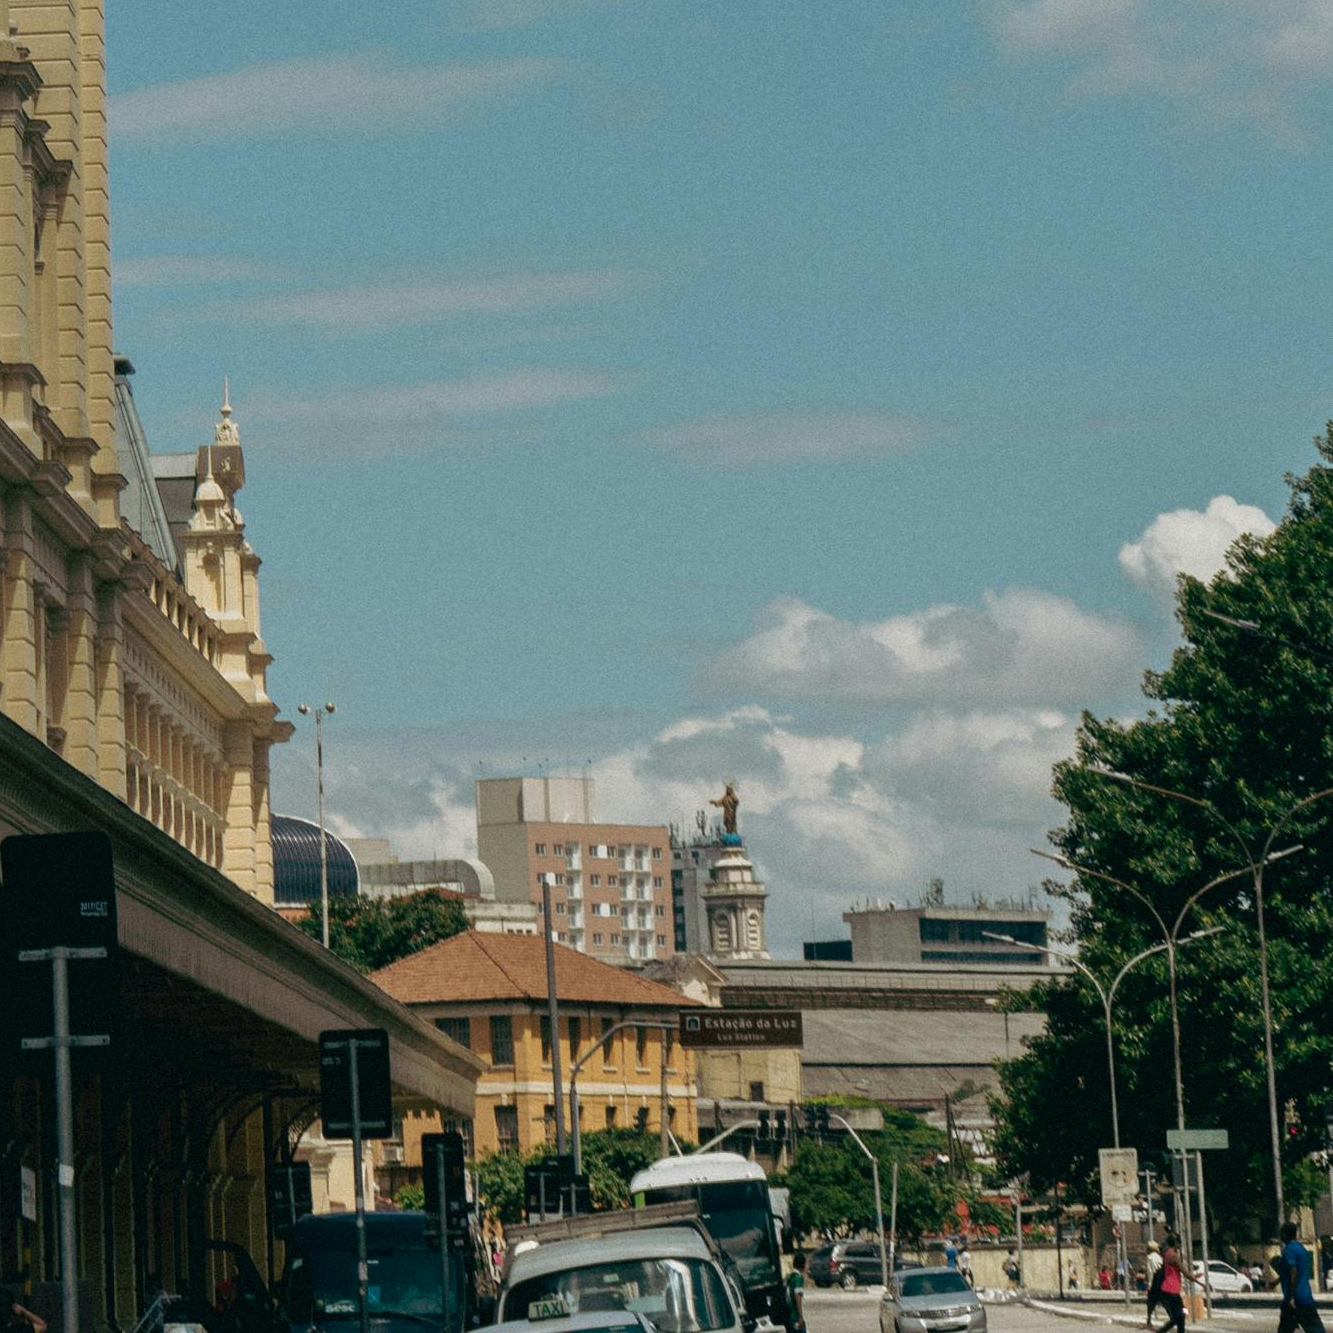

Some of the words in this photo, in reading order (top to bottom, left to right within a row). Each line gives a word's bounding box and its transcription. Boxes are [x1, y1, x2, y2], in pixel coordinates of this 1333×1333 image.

[704, 1017, 753, 1030] Estação
[756, 1017, 771, 1029] da
[774, 1017, 797, 1029] Luz
[533, 1299, 565, 1315] TAXI
